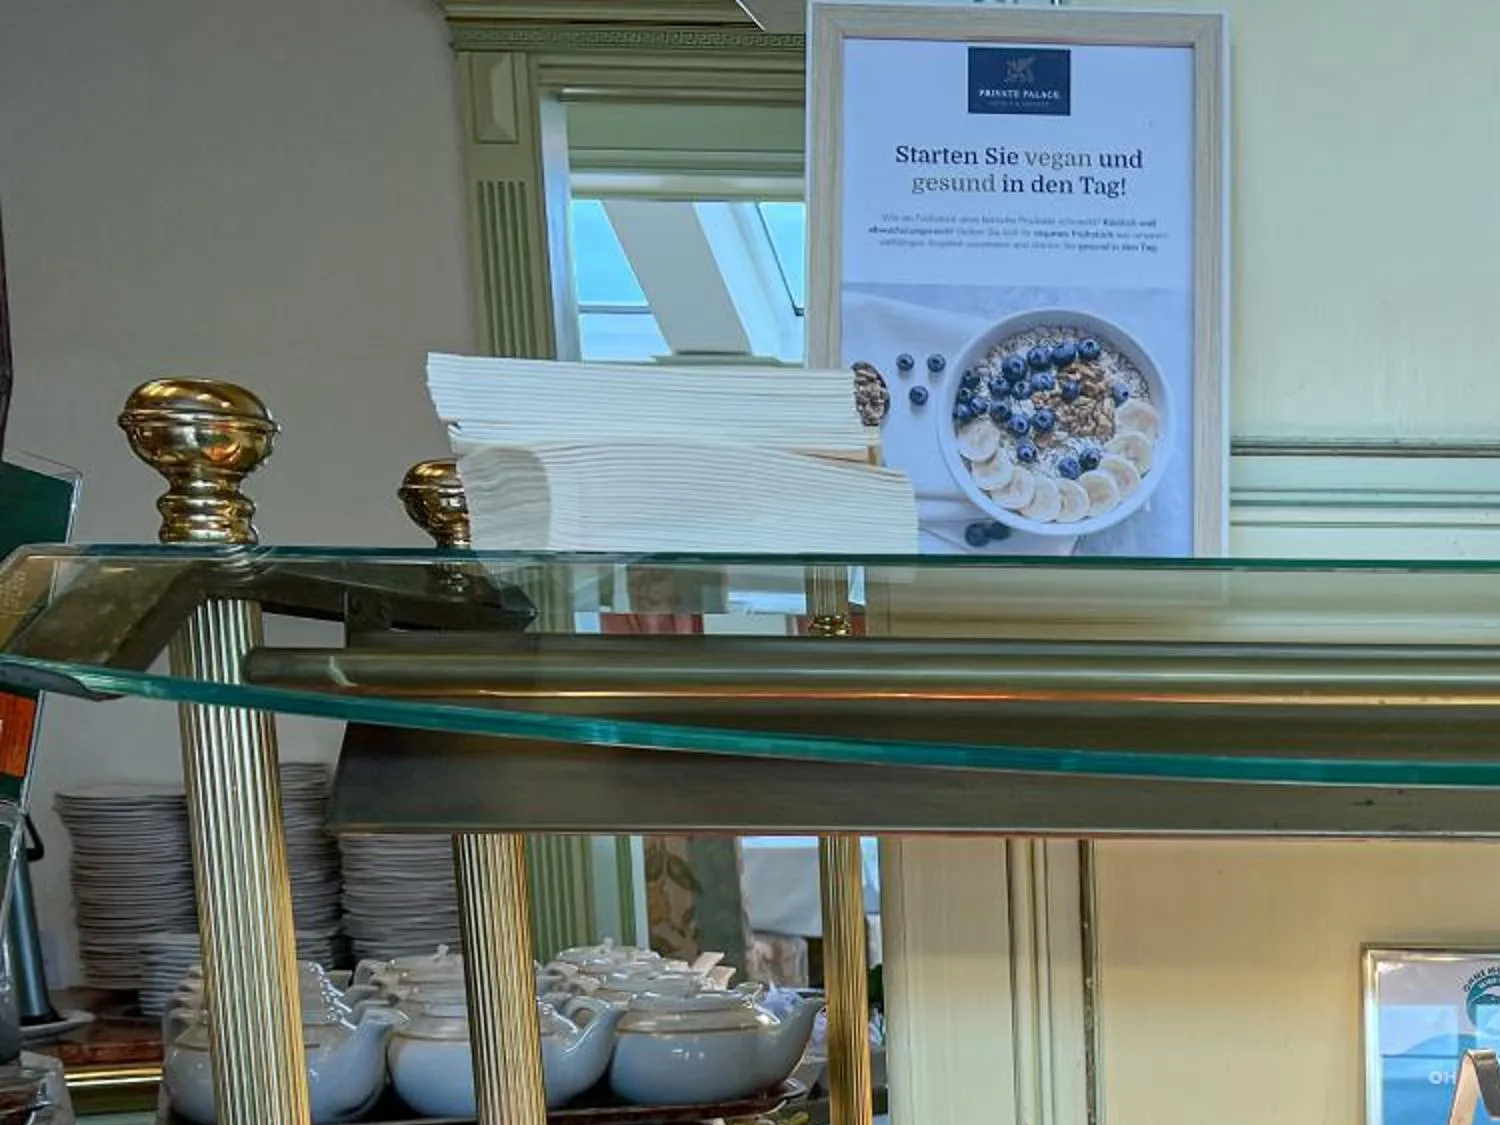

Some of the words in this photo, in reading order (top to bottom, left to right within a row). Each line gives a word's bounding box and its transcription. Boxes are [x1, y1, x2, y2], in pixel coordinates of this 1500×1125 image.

[895, 145, 979, 165] Starten
[985, 147, 1019, 165] Sie
[1025, 152, 1092, 170] vegan
[1099, 150, 1143, 169] und
[911, 174, 996, 195] gesund
[1002, 174, 1024, 193] in
[1031, 175, 1073, 194] den
[1079, 176, 1127, 198] Tag!
[1428, 1071, 1457, 1085] OH
